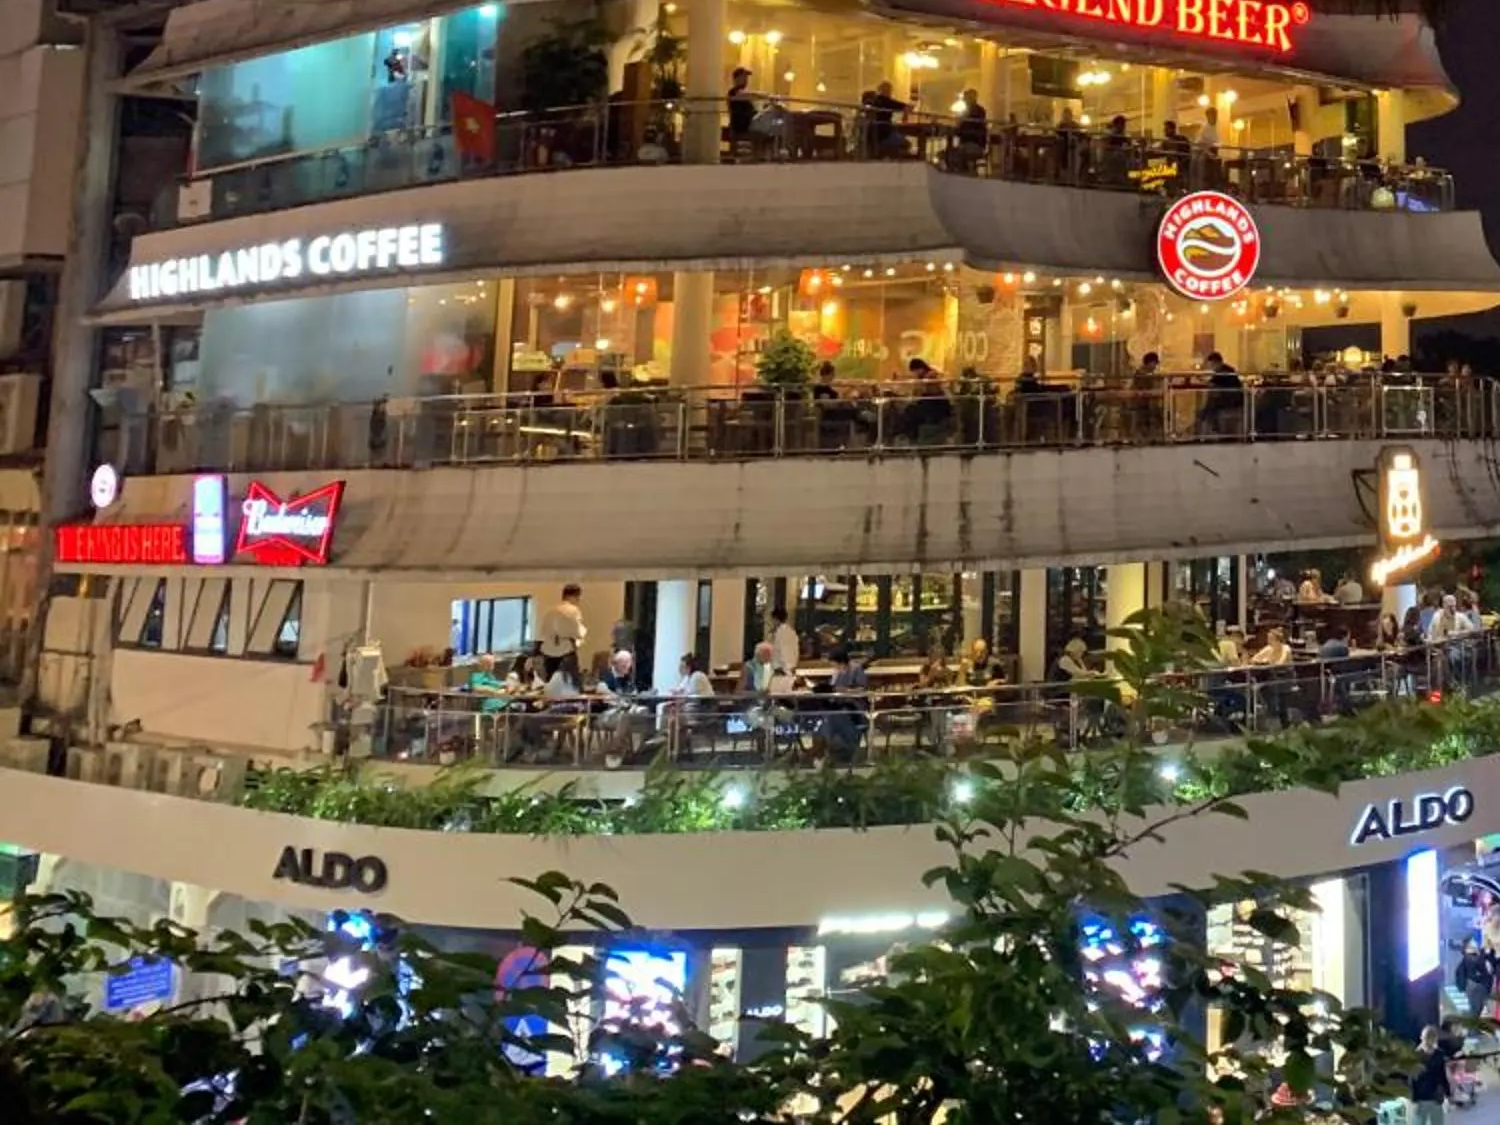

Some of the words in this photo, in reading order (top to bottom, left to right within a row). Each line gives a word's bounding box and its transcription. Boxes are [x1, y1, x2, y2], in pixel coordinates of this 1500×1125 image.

[1163, 198, 1255, 244] HIGHLANDS
[129, 238, 302, 300] HIGHLANDS
[308, 223, 443, 275] COFFEE
[1174, 268, 1245, 294] COFFEE
[1350, 785, 1474, 845] ALDO
[272, 845, 388, 894] ALDO
